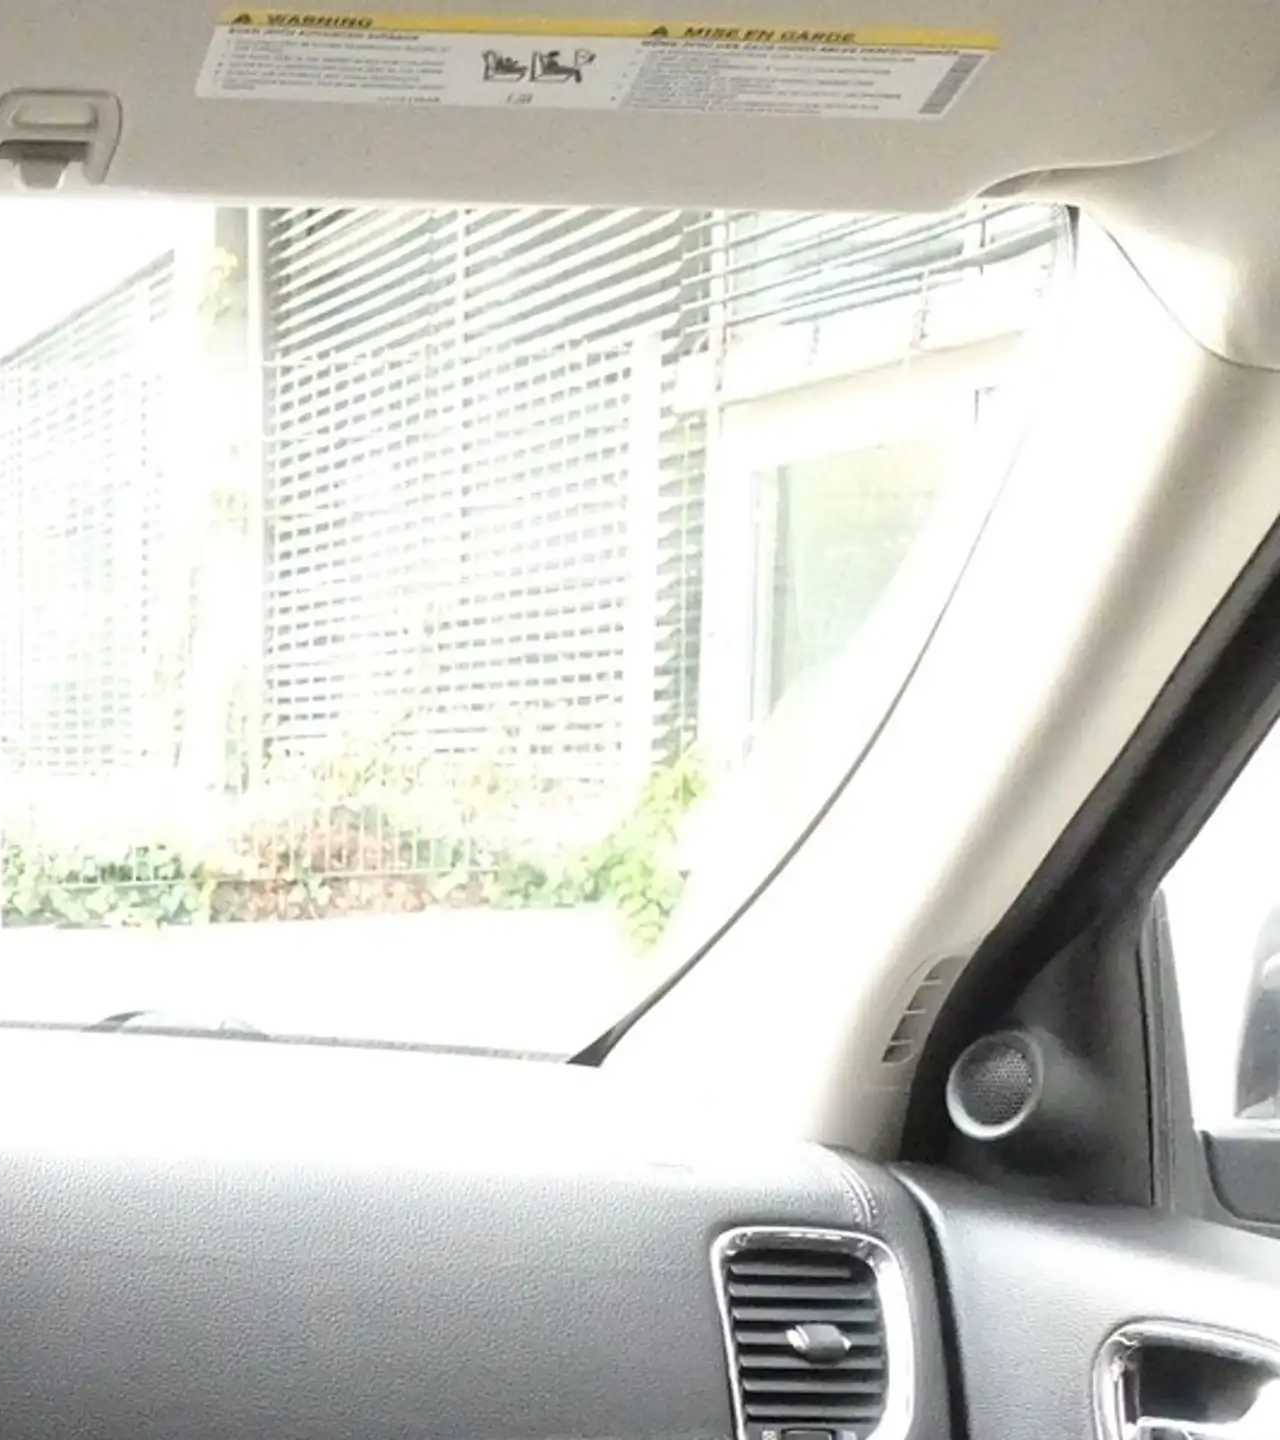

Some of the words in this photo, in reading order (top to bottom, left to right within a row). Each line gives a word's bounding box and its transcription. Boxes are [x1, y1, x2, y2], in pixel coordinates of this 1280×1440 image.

[265, 14, 374, 28] WARNING
[683, 26, 741, 39] MISE
[743, 29, 776, 41] EN
[779, 31, 857, 43] GARDE
